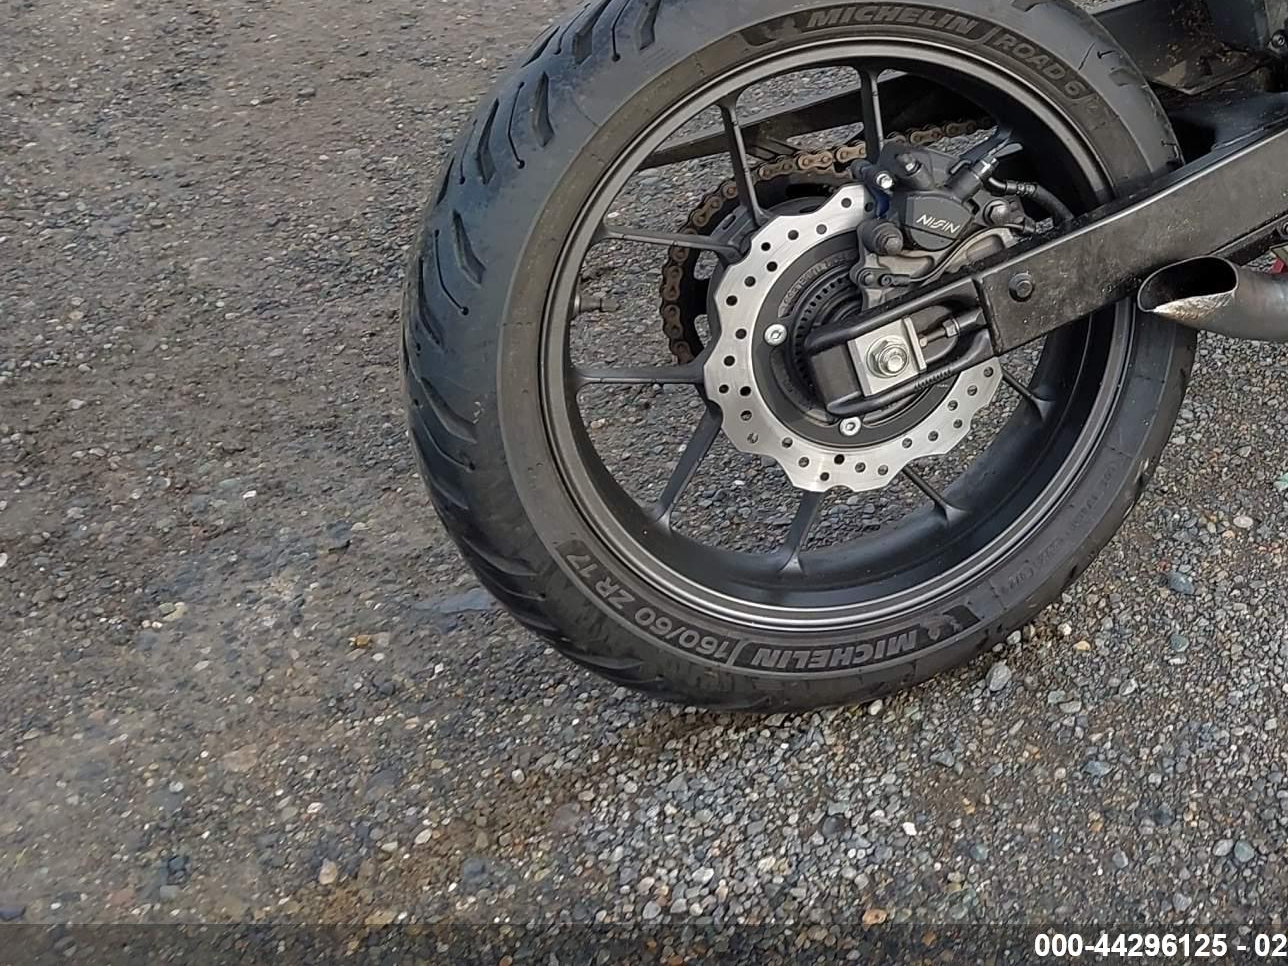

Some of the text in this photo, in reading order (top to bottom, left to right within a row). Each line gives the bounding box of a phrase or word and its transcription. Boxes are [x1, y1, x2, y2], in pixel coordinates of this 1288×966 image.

[806, 5, 1081, 99] MICHELIN ROAD 6
[915, 214, 961, 234] NISSIN
[566, 553, 917, 670] MICHELIN 160/60 ZR 17
